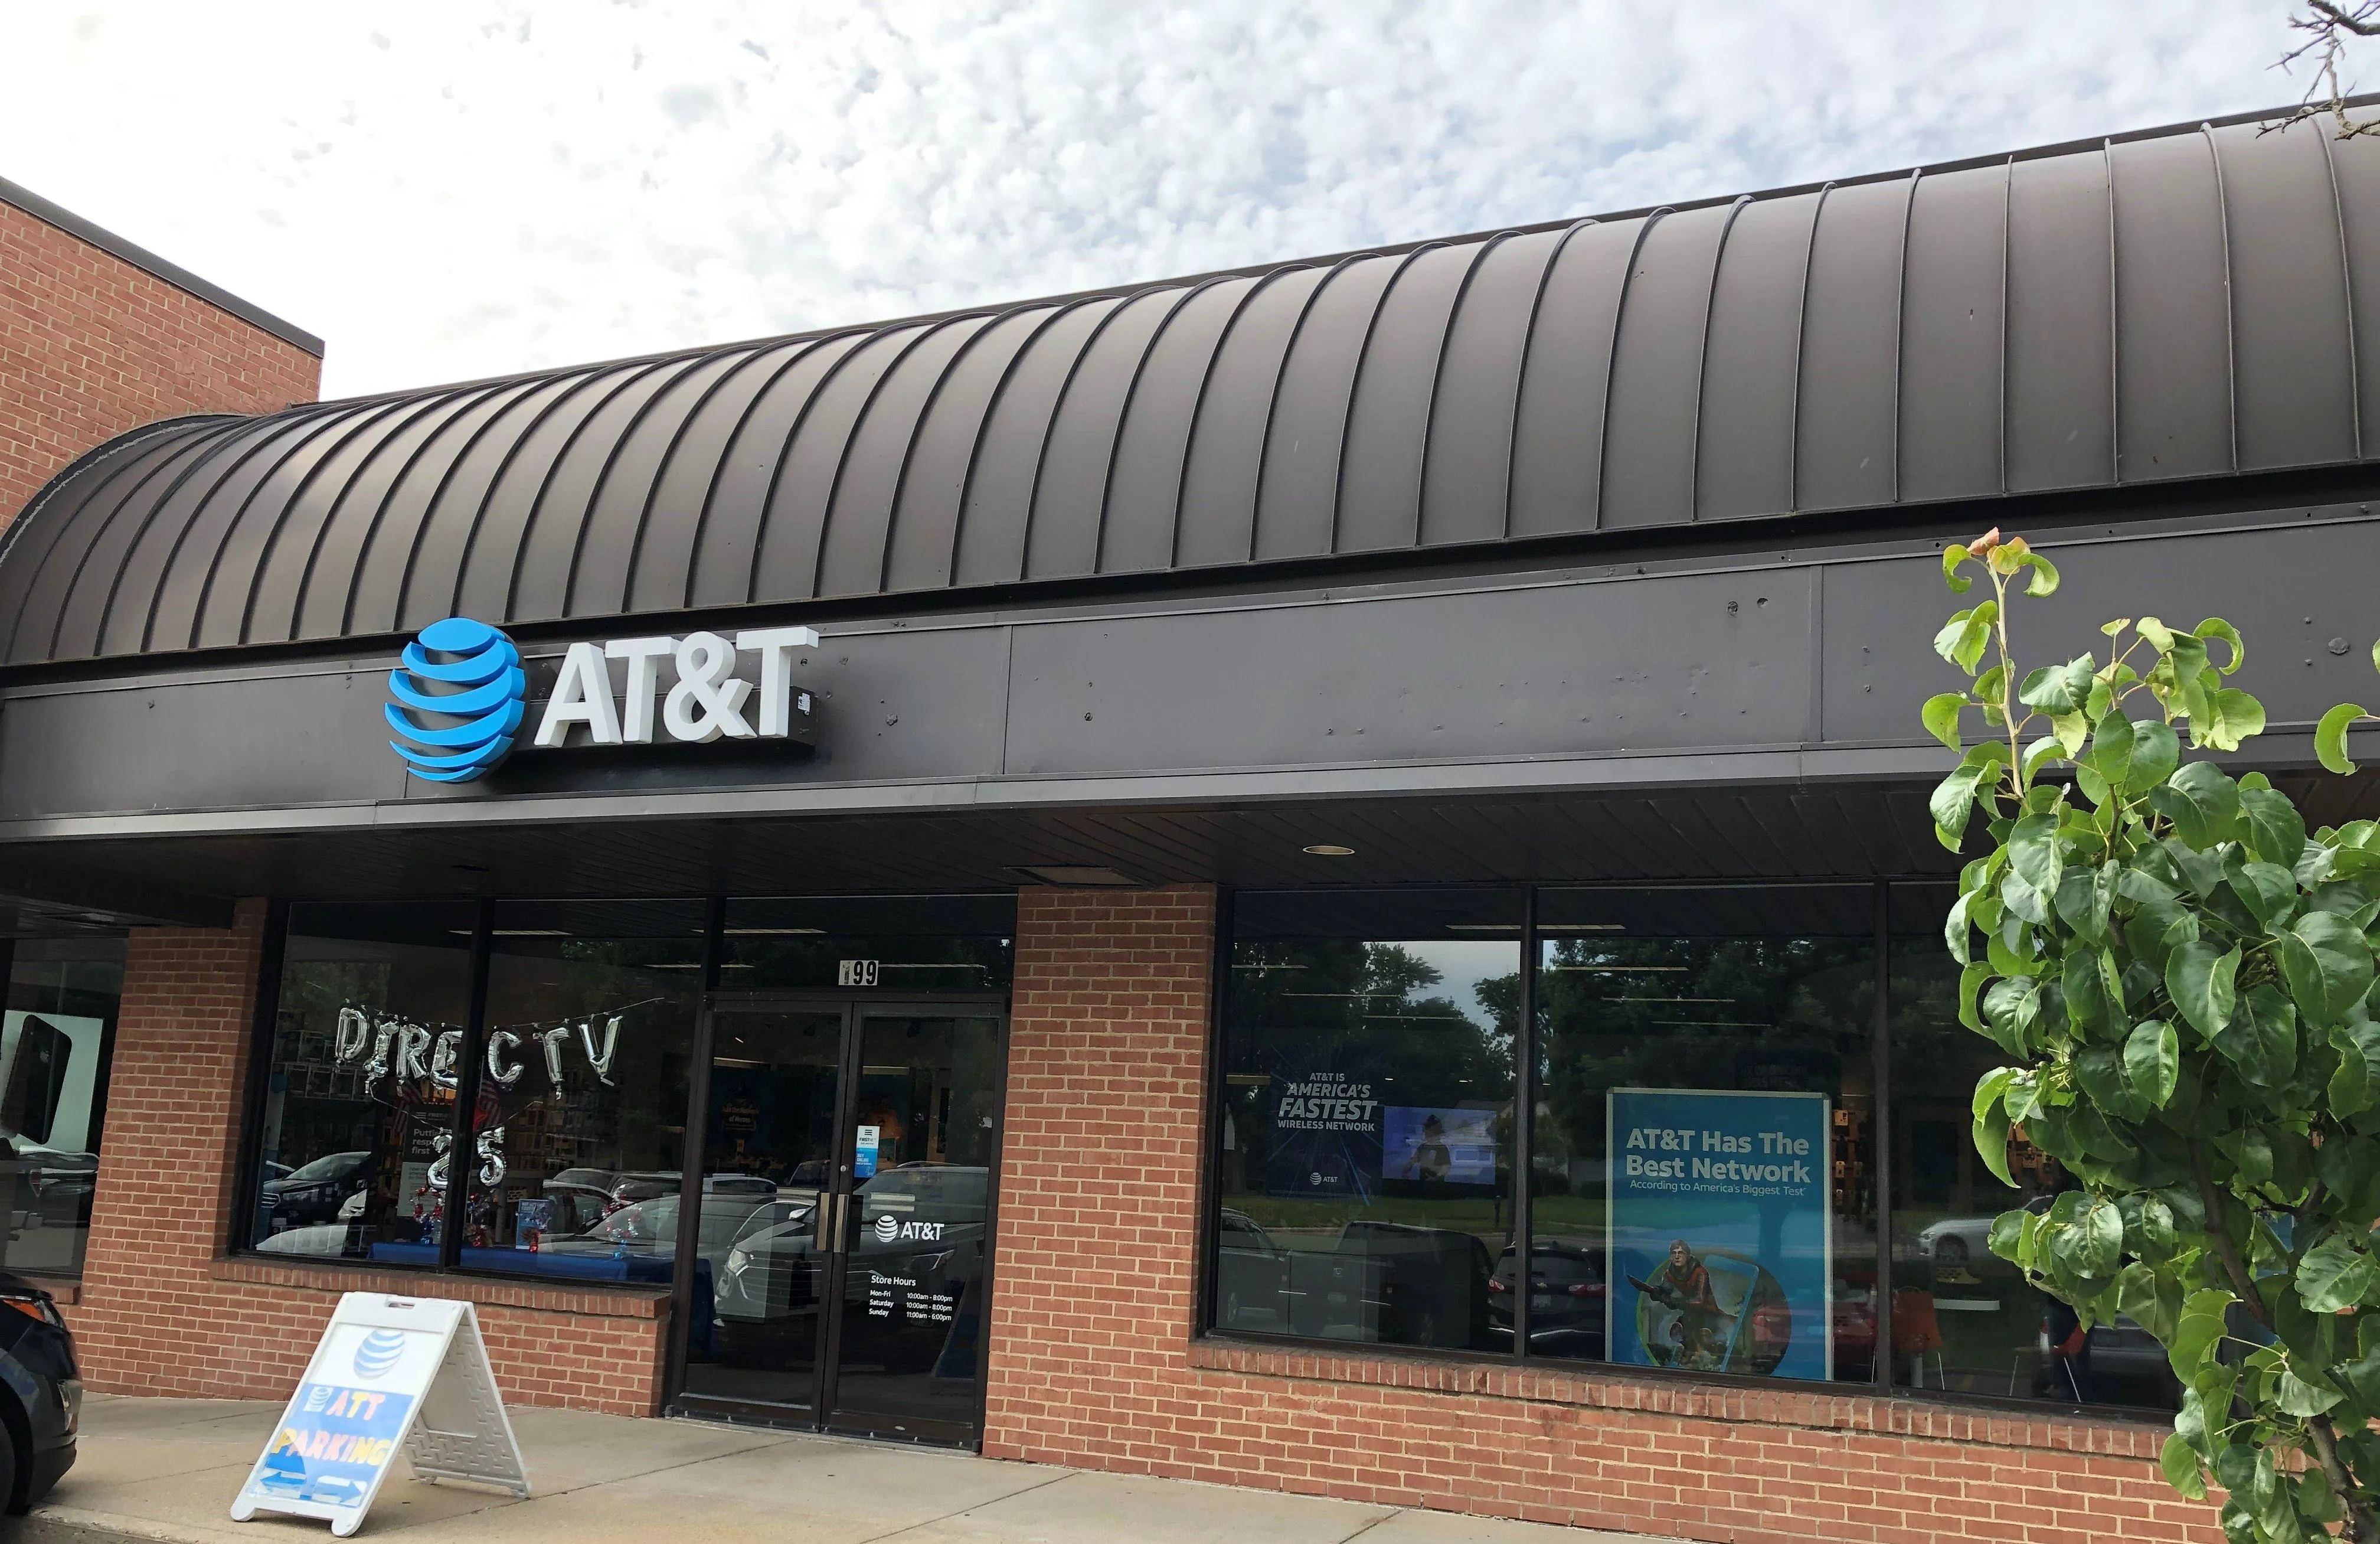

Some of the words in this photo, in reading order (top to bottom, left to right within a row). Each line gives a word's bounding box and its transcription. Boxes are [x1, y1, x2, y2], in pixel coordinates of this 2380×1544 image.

[534, 626, 819, 747] AT&T
[1309, 1072, 1333, 1081] AT&T
[1336, 1073, 1345, 1082] IS
[1287, 1082, 1371, 1098] AMERICA'S
[1279, 1098, 1378, 1120] FASTEST
[1277, 1119, 1324, 1129] WIRELESS
[1326, 1121, 1375, 1131] NETWORK
[1626, 1128, 1695, 1150] AT&T
[1702, 1131, 1752, 1153] Has
[1758, 1132, 1809, 1155] The
[1626, 1155, 1685, 1178] Best
[1692, 1157, 1812, 1183] Network
[1630, 1180, 1678, 1193] According
[1680, 1183, 1691, 1191] to
[1693, 1183, 1740, 1193] America's
[1742, 1184, 1780, 1196] Biggest
[900, 1221, 944, 1241] AT&T
[871, 1275, 892, 1285] Store
[893, 1277, 916, 1286] Hours
[869, 1299, 894, 1308] Saturday
[933, 1294, 953, 1303] 8:00pm
[869, 1308, 889, 1317] Sunday
[931, 1313, 952, 1321] 6:00pm
[326, 1390, 386, 1421] ATT
[270, 1428, 393, 1466] PARKING
